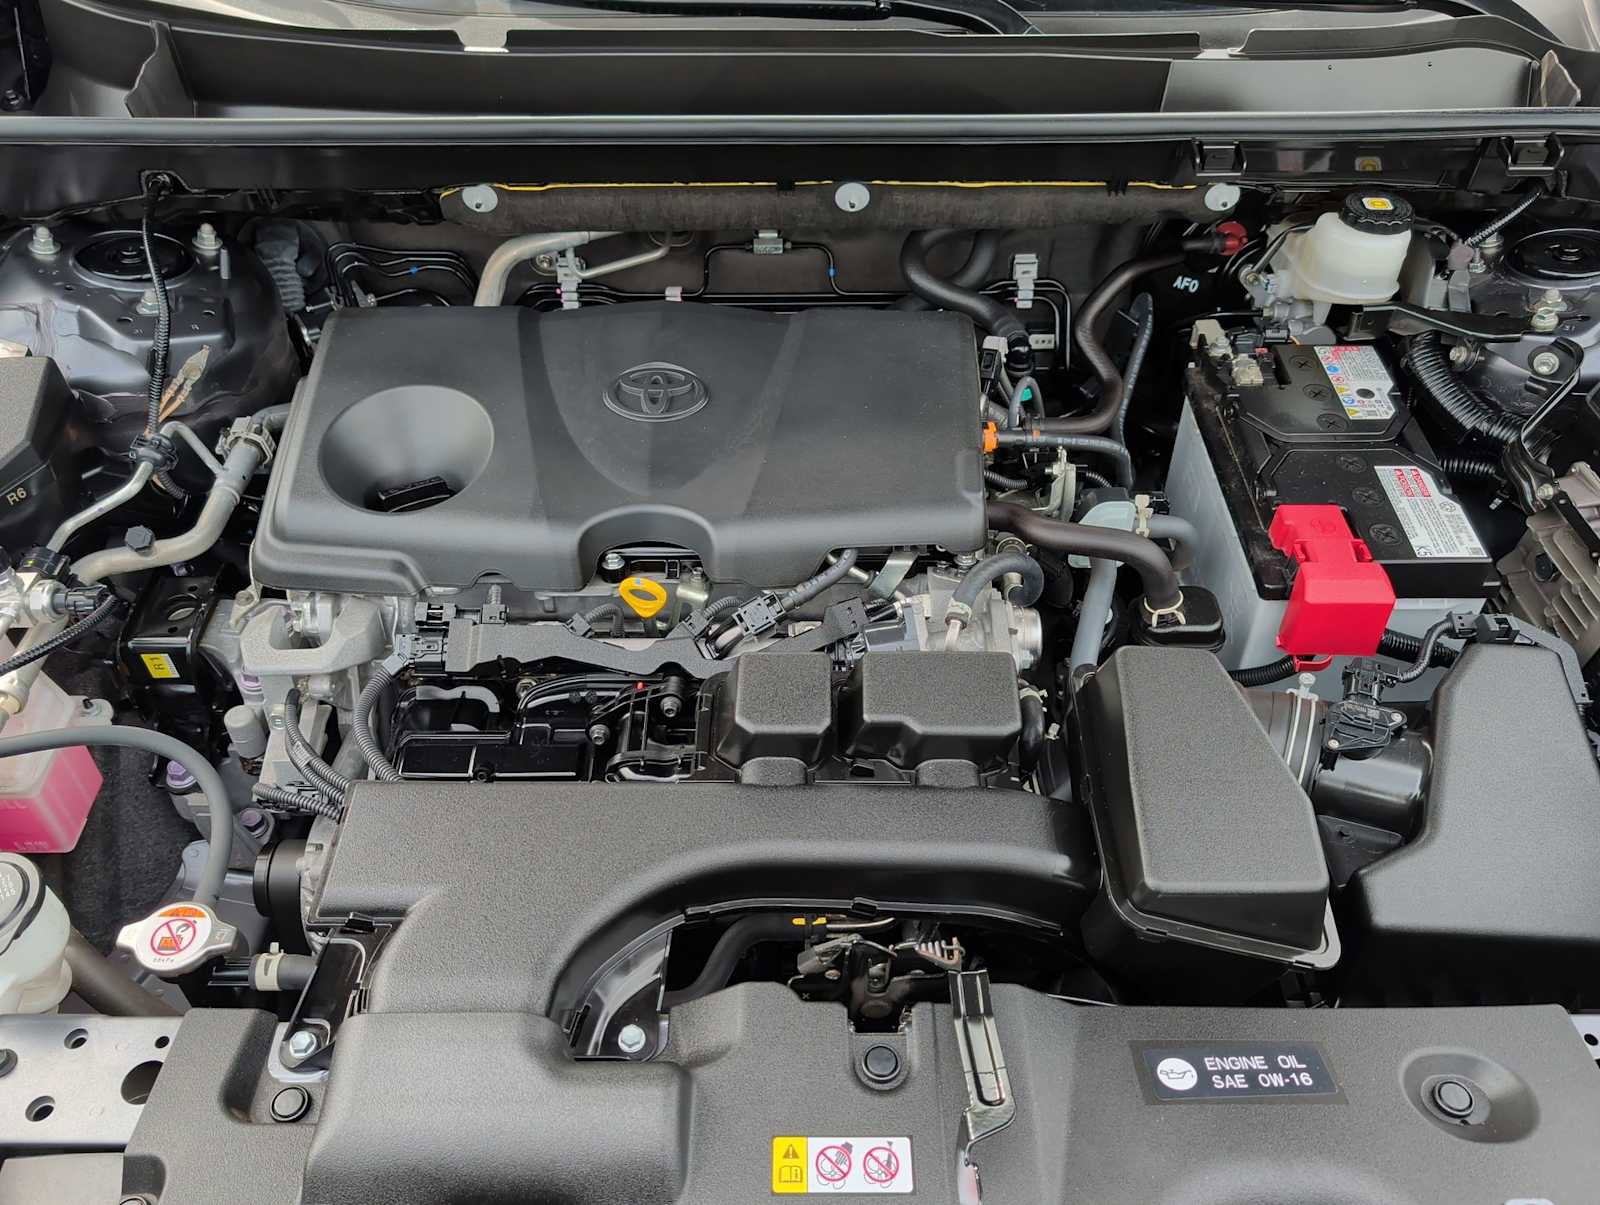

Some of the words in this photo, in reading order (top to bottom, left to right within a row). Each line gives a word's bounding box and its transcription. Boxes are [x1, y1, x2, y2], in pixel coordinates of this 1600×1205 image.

[6, 487, 27, 505] R6
[1204, 1056, 1268, 1070] ENGINE
[1277, 1055, 1306, 1069] OIL
[1212, 1074, 1248, 1088] SAE
[1258, 1072, 1313, 1087] 0W-16
